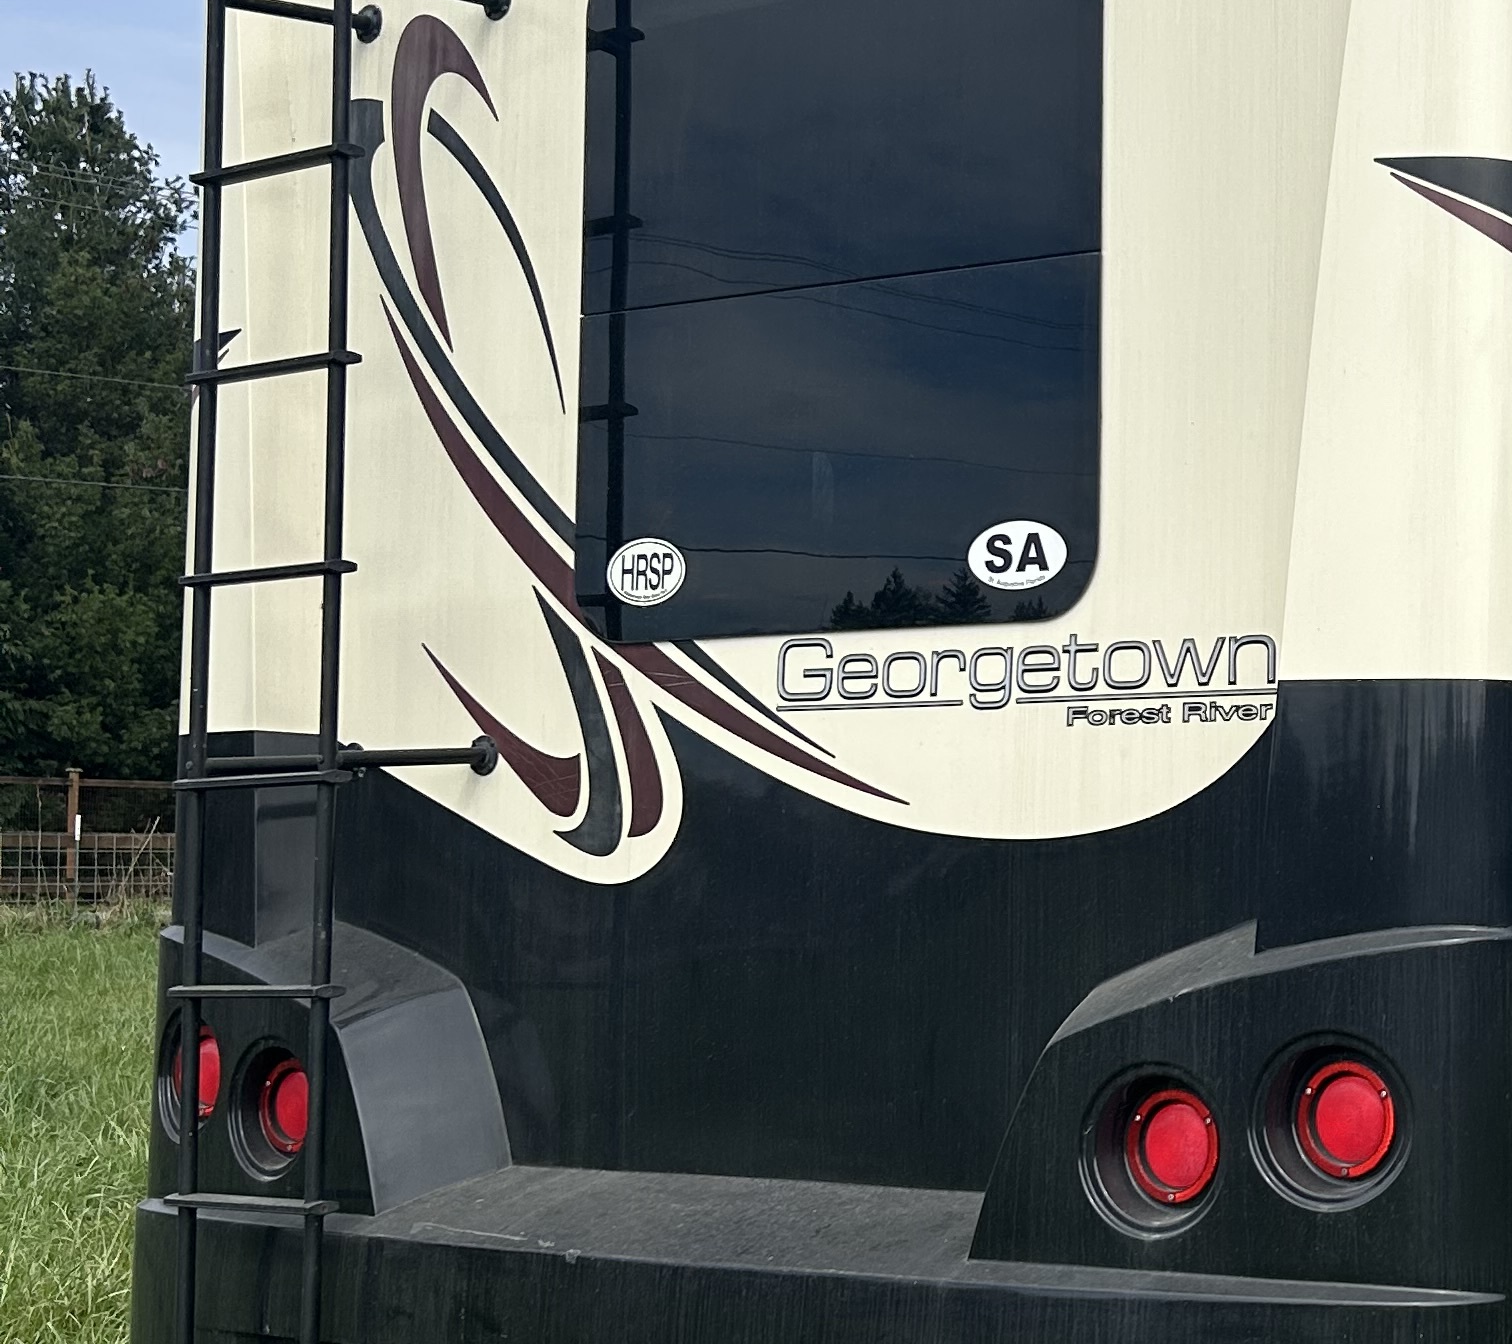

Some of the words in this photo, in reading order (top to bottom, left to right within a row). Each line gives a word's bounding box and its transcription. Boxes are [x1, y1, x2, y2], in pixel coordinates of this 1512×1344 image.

[621, 552, 674, 591] HRSP
[985, 533, 1049, 573] SA
[777, 633, 1277, 711] Georgetown
[1066, 703, 1171, 727] Forest
[1182, 700, 1274, 724] River
